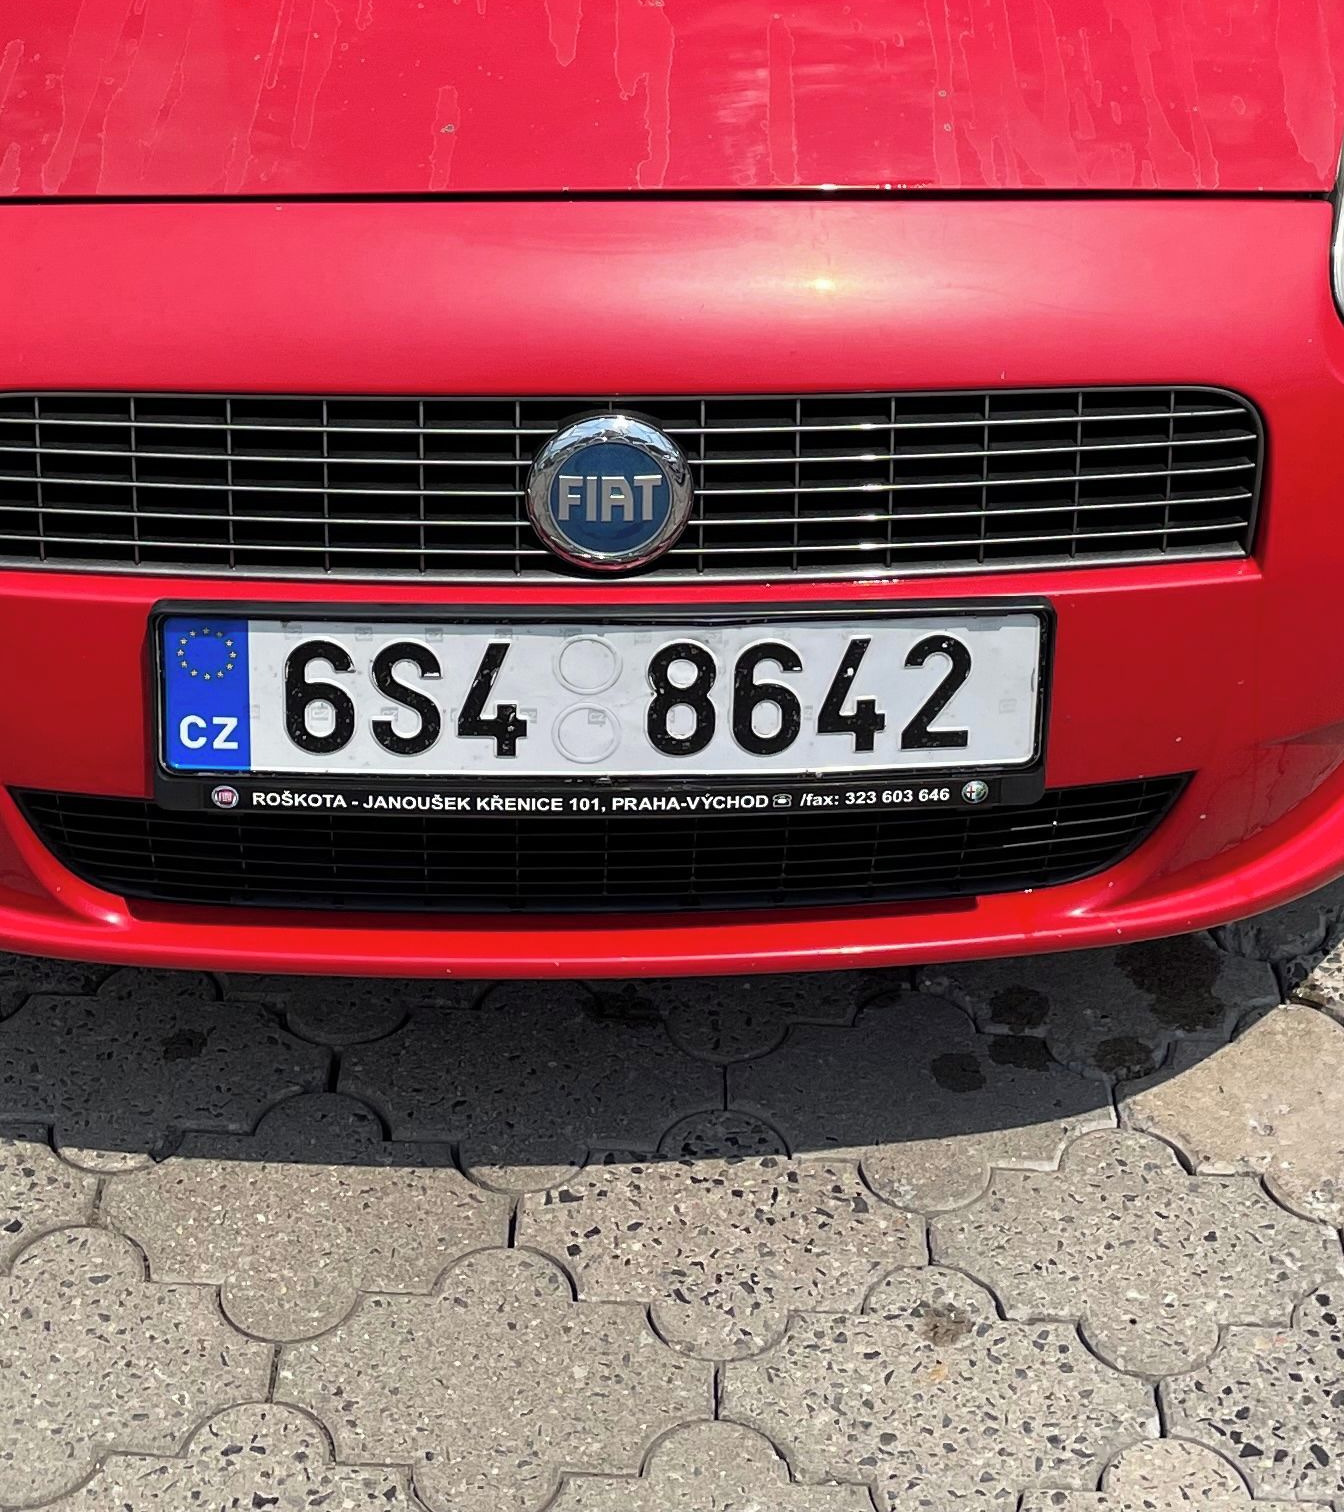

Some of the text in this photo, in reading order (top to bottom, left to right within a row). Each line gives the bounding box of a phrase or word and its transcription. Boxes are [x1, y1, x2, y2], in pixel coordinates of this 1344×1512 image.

[558, 475, 663, 522] FIAT
[284, 635, 972, 757] 6S4 8642
[179, 715, 239, 750] CZ
[252, 790, 348, 808] ROŠKOTA
[362, 792, 471, 811] JANOUŠEK
[476, 792, 564, 812] KŘENICE
[569, 797, 607, 813] 101,
[611, 789, 769, 811] PRAHA-VÝCHOD
[799, 793, 840, 808] /fax:
[844, 791, 877, 805] 323
[881, 789, 914, 804] 603
[918, 787, 951, 803] 646
